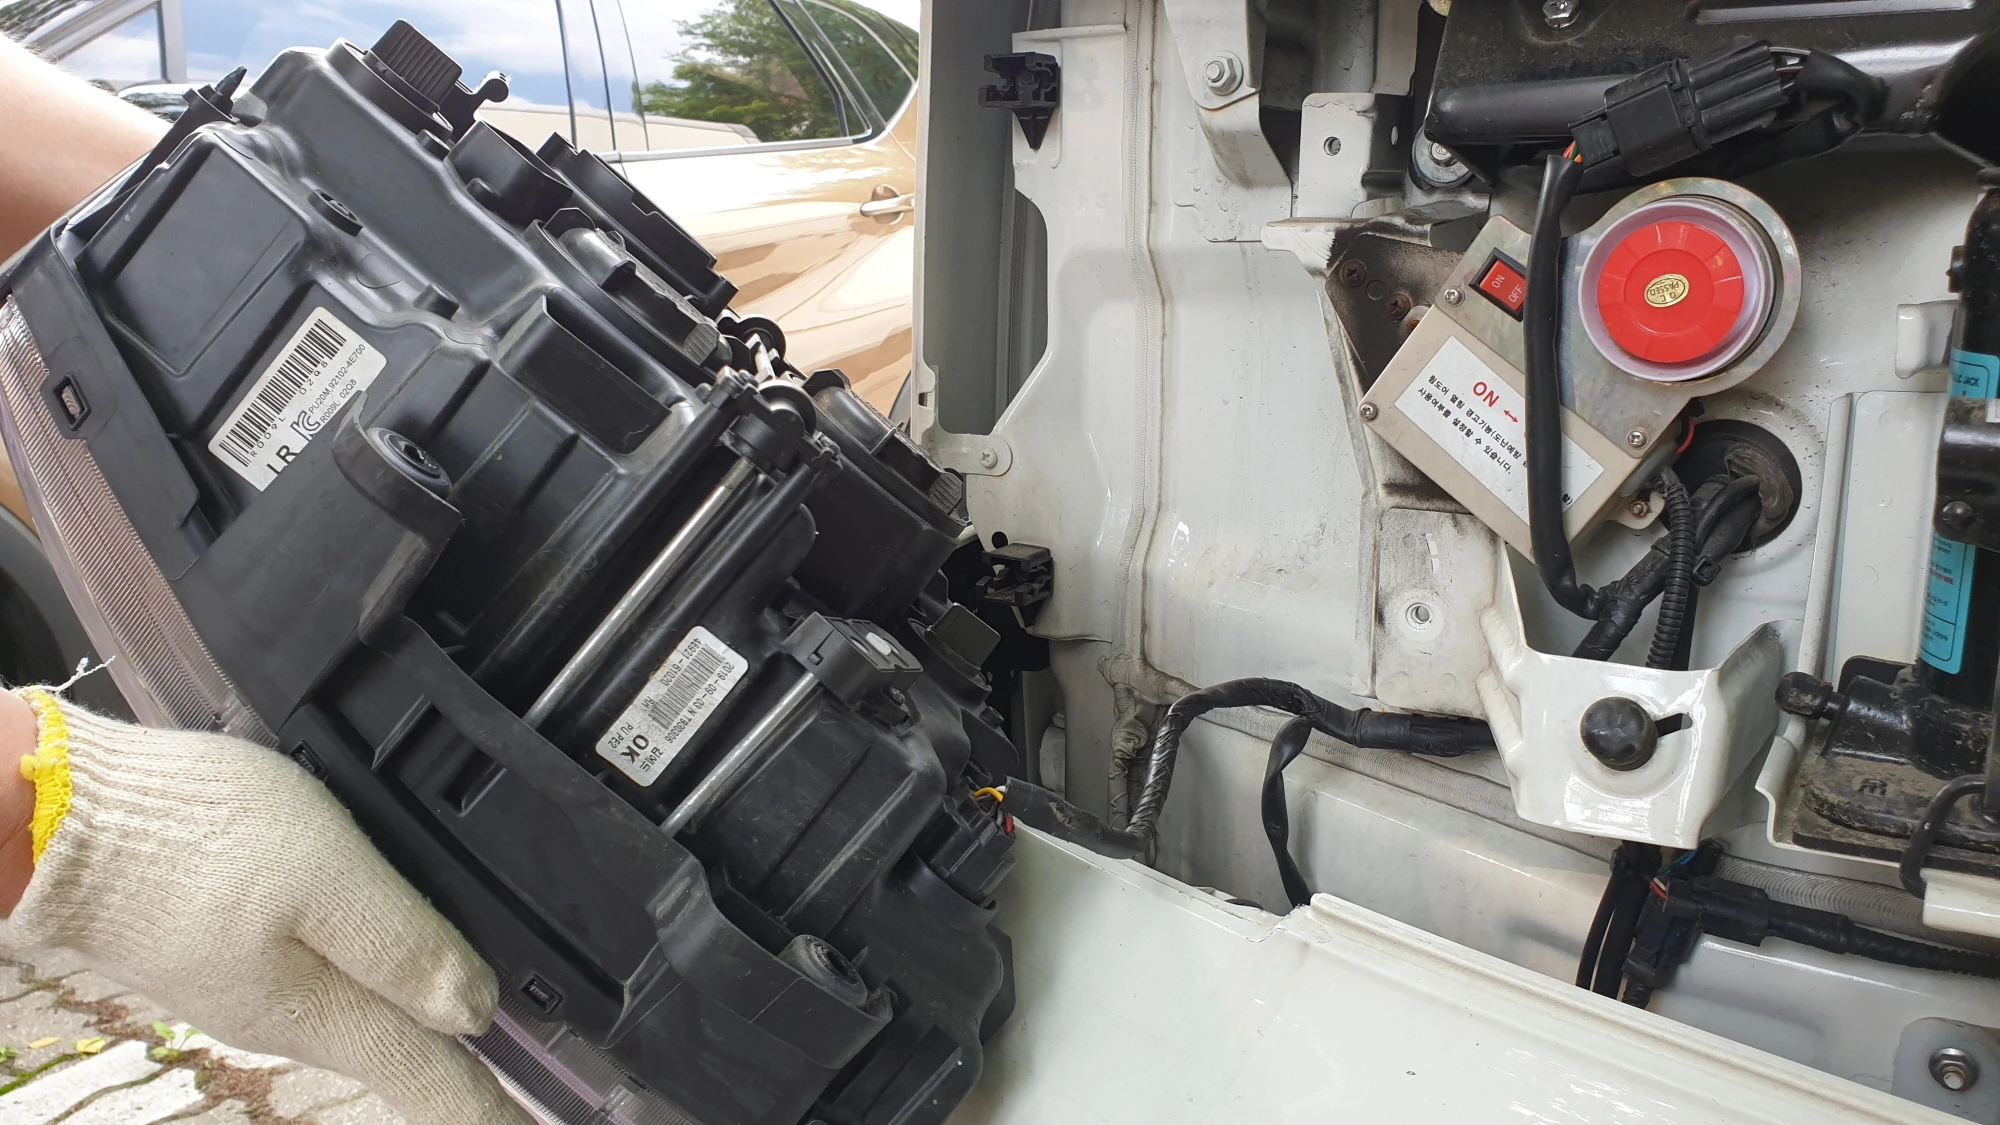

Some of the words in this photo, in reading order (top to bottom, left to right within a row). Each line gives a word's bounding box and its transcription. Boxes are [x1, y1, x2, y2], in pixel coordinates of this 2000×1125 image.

[1491, 274, 1506, 289] ON
[1650, 280, 1679, 296] PASSED
[1508, 284, 1523, 303] OFF
[320, 401, 340, 423] R009L
[340, 379, 356, 398] 02Q8
[1473, 382, 1499, 407] ON
[1418, 388, 1451, 418] 사용여부를
[1452, 418, 1473, 438] 설정할
[1473, 437, 1483, 446] 수
[642, 696, 655, 709] RH
[621, 722, 633, 735] PU
[665, 715, 692, 743] T930306
[608, 732, 624, 748] PE2
[620, 735, 649, 764] OK
